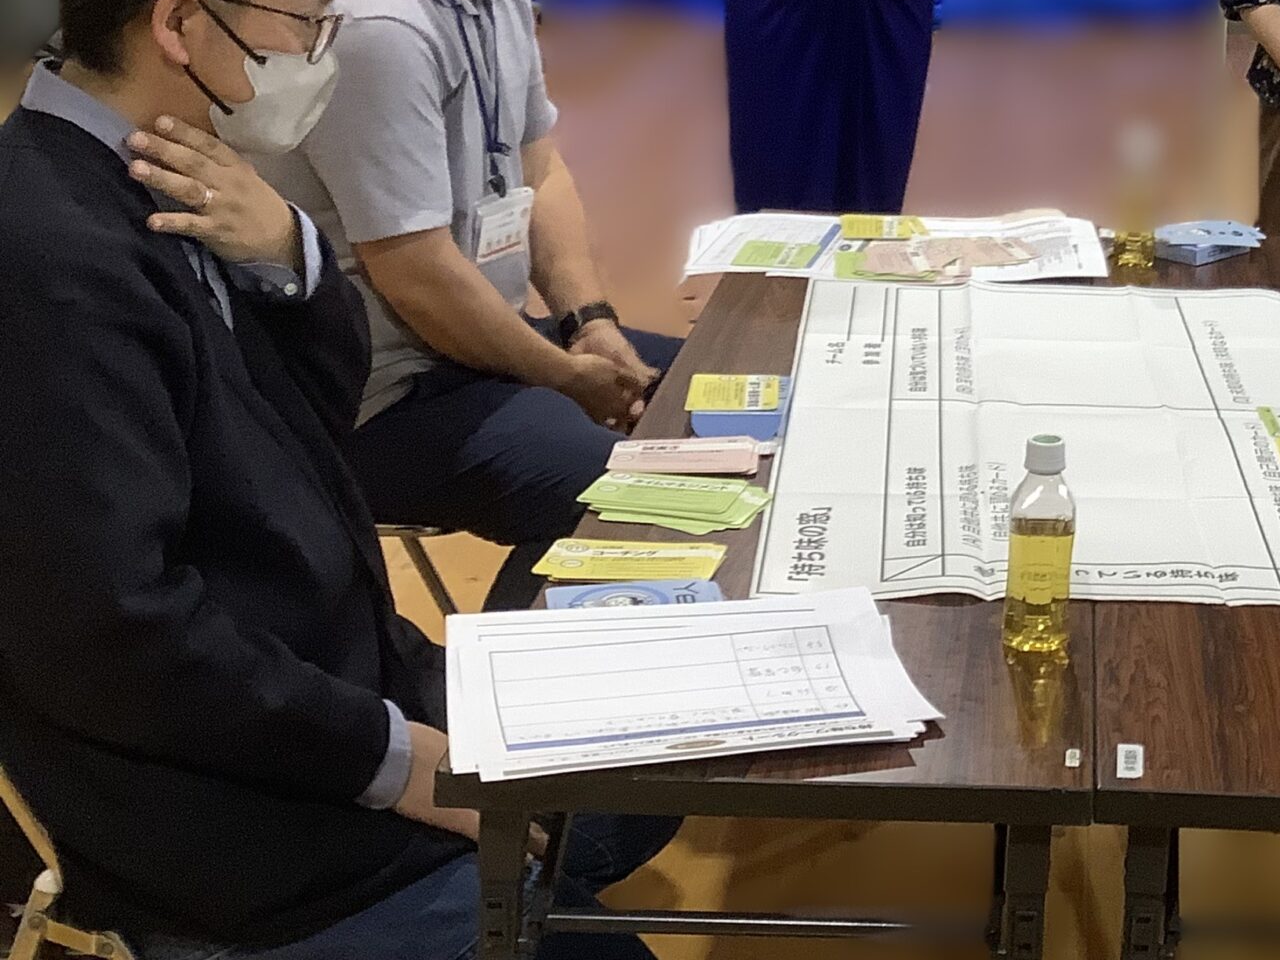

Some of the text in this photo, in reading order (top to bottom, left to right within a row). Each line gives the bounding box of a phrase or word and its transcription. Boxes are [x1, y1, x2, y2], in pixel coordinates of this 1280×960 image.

[787, 506, 833, 583] 「持ち味の窓」
[903, 466, 929, 549] 自分は知っている持ち味
